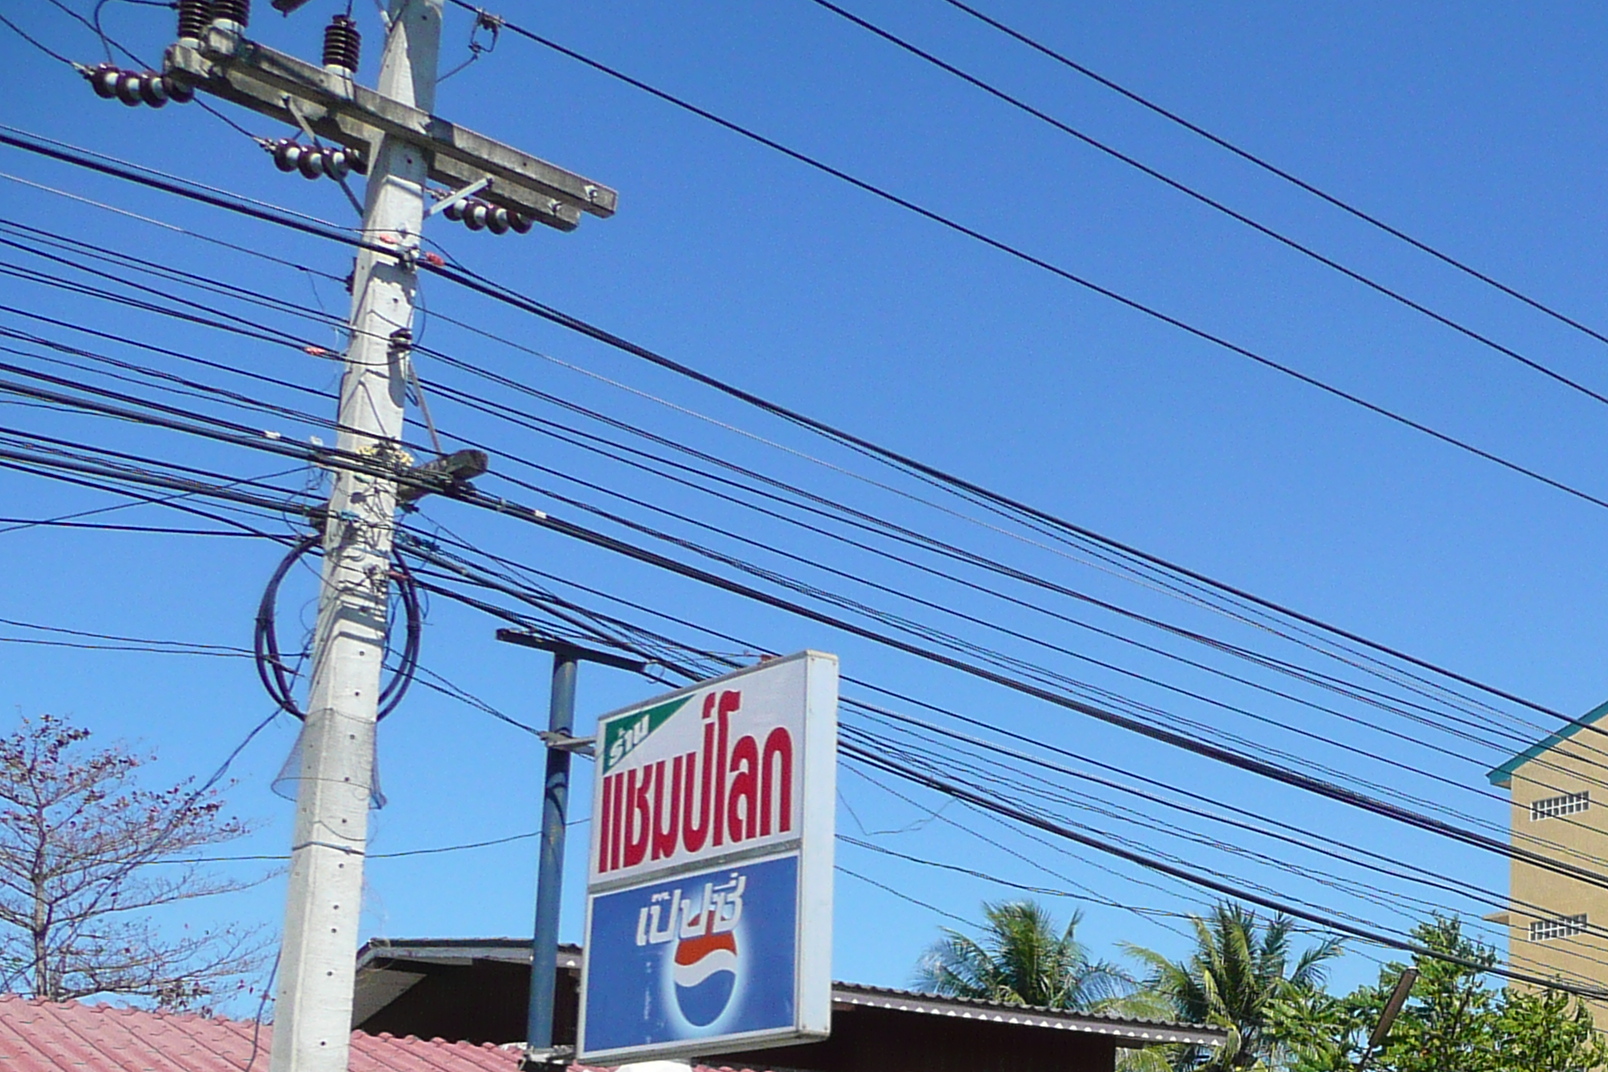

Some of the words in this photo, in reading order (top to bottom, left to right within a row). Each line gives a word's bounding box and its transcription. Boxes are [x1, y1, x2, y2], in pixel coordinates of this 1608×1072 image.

[599, 690, 791, 874] แชมป์โลก
[636, 872, 747, 946] เป๊ปซี่
